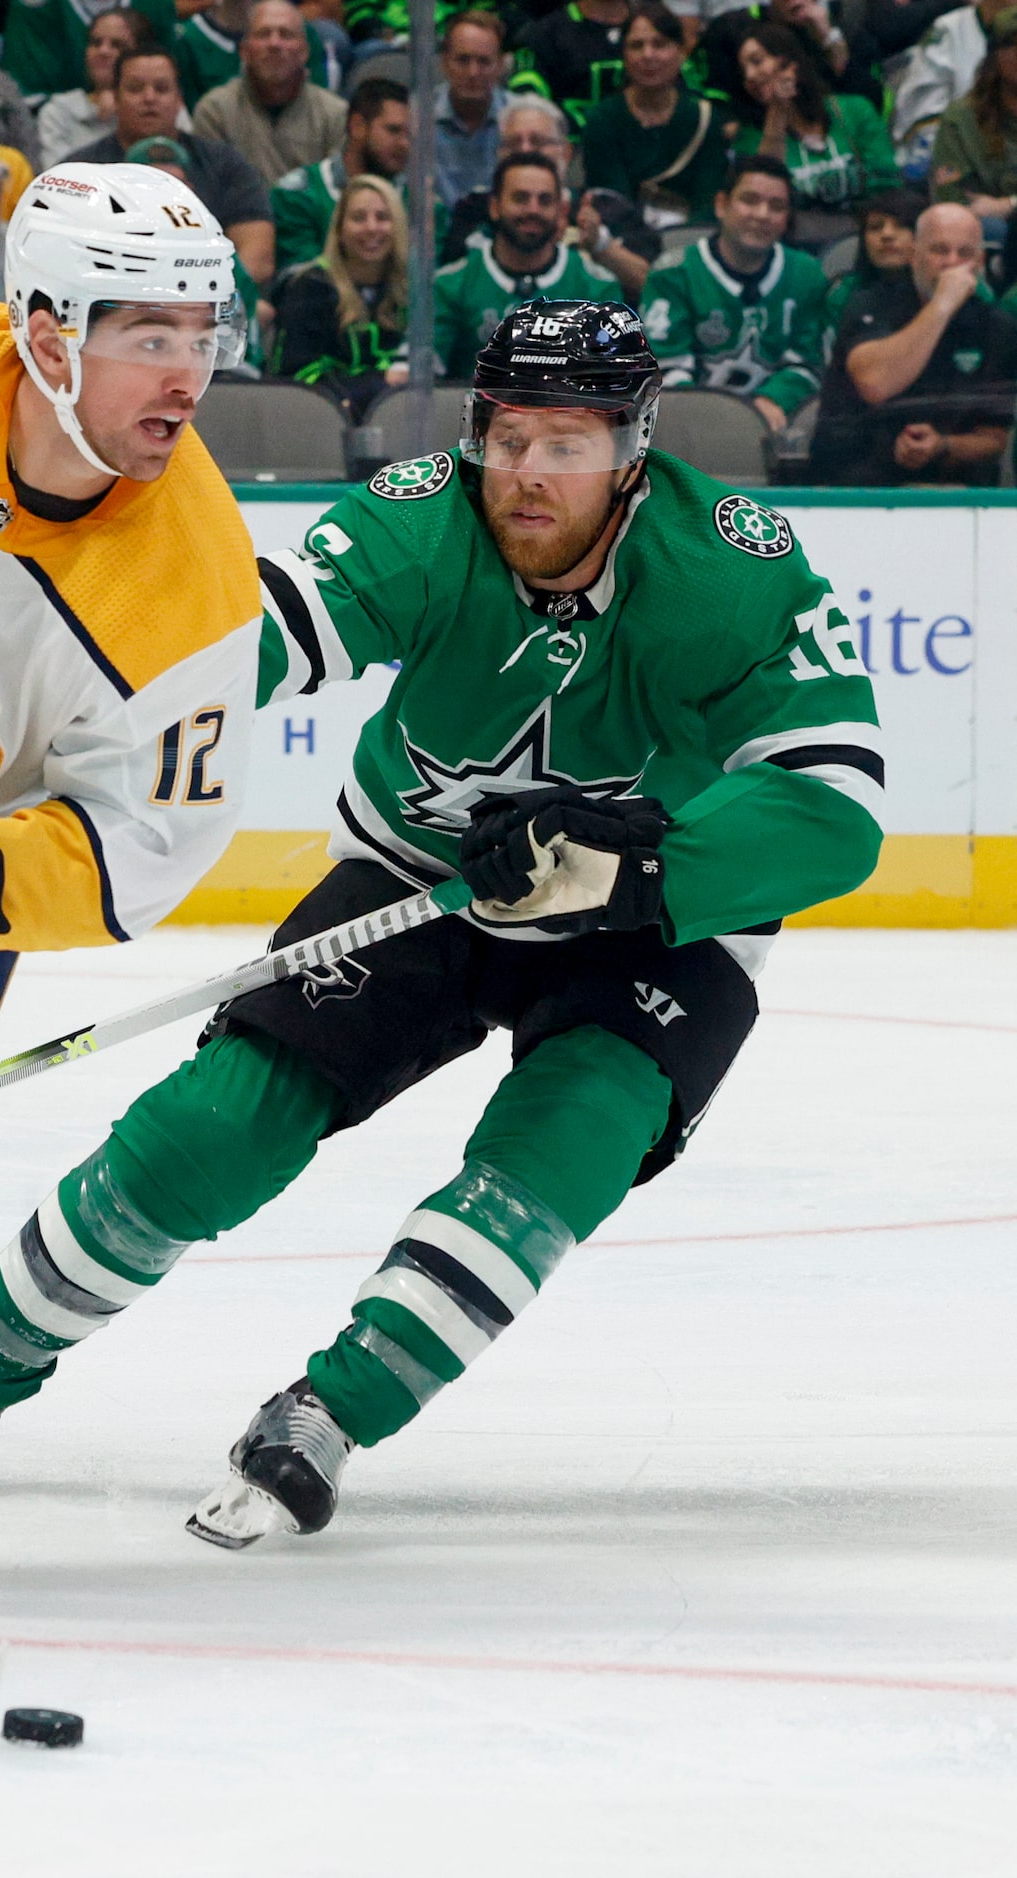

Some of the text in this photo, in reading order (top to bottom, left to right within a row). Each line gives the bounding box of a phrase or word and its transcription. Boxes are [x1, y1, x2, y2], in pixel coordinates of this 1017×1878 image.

[160, 204, 203, 229] 12
[173, 257, 222, 268] BAUER
[530, 315, 561, 337] 16
[510, 353, 569, 366] WARRIOR
[720, 498, 789, 554] DALLAS STARS
[788, 592, 870, 682] 16
[855, 588, 974, 676] ite
[284, 717, 316, 755] H
[148, 703, 227, 807] 12
[641, 859, 659, 874] 16
